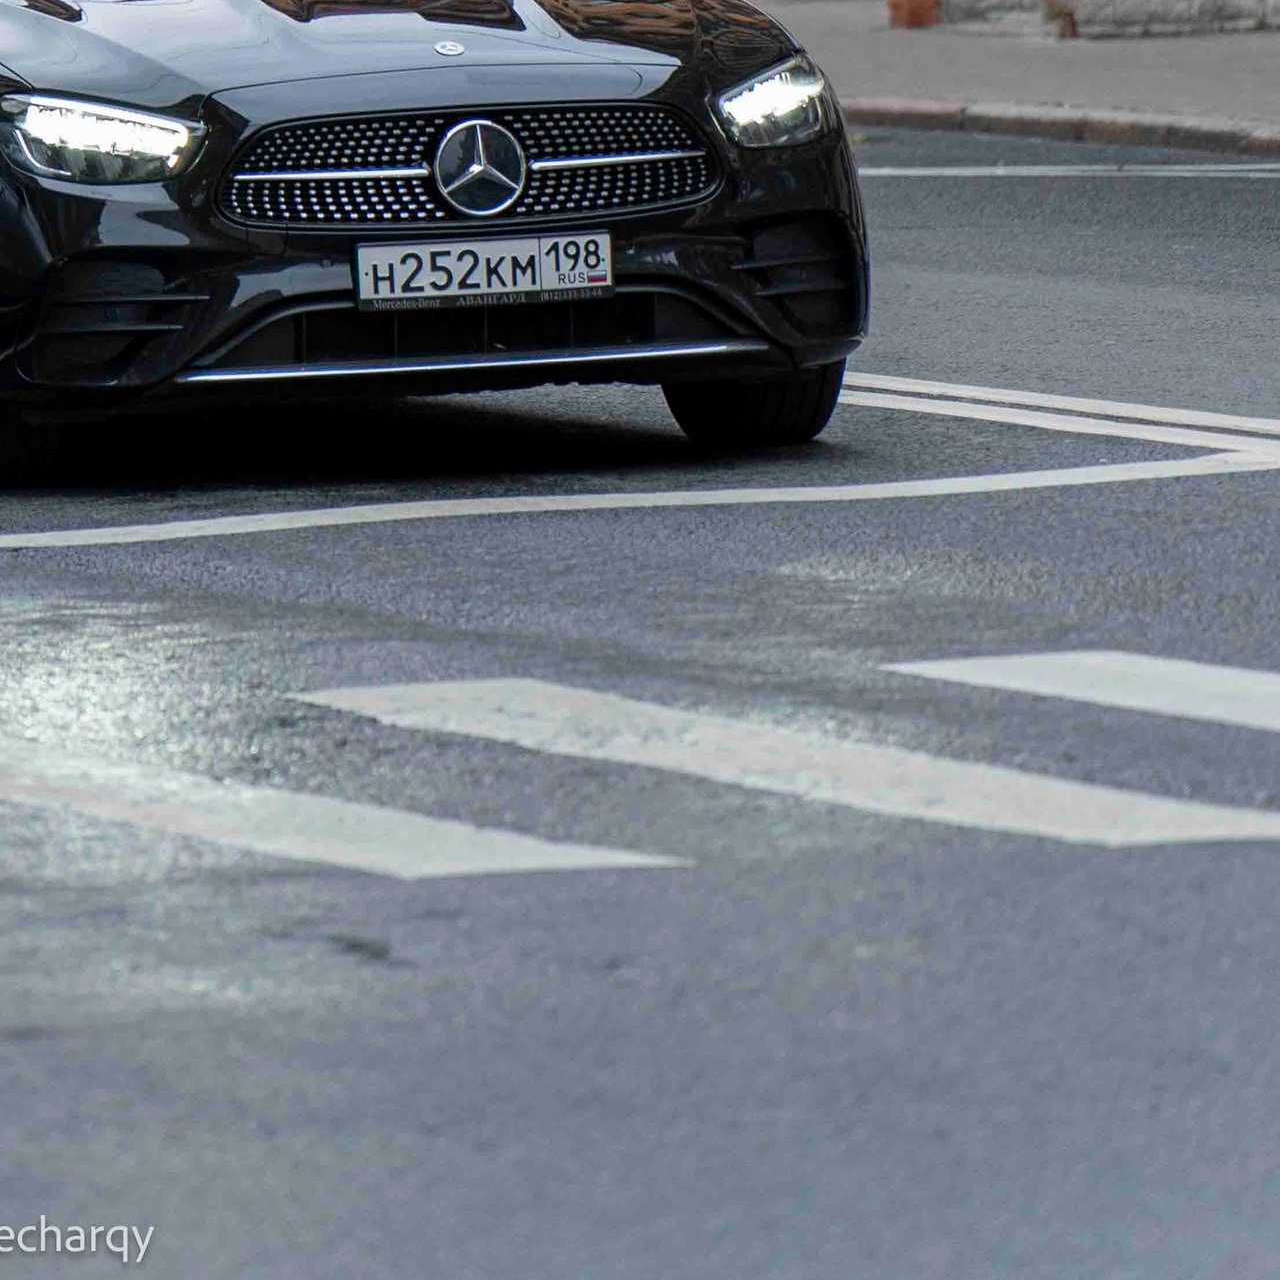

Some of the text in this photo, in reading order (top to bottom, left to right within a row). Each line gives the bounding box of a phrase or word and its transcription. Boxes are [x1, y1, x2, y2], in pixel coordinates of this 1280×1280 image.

[545, 239, 601, 272] 198
[557, 272, 587, 285] RUS
[373, 297, 441, 312] Mercedes-Benz
